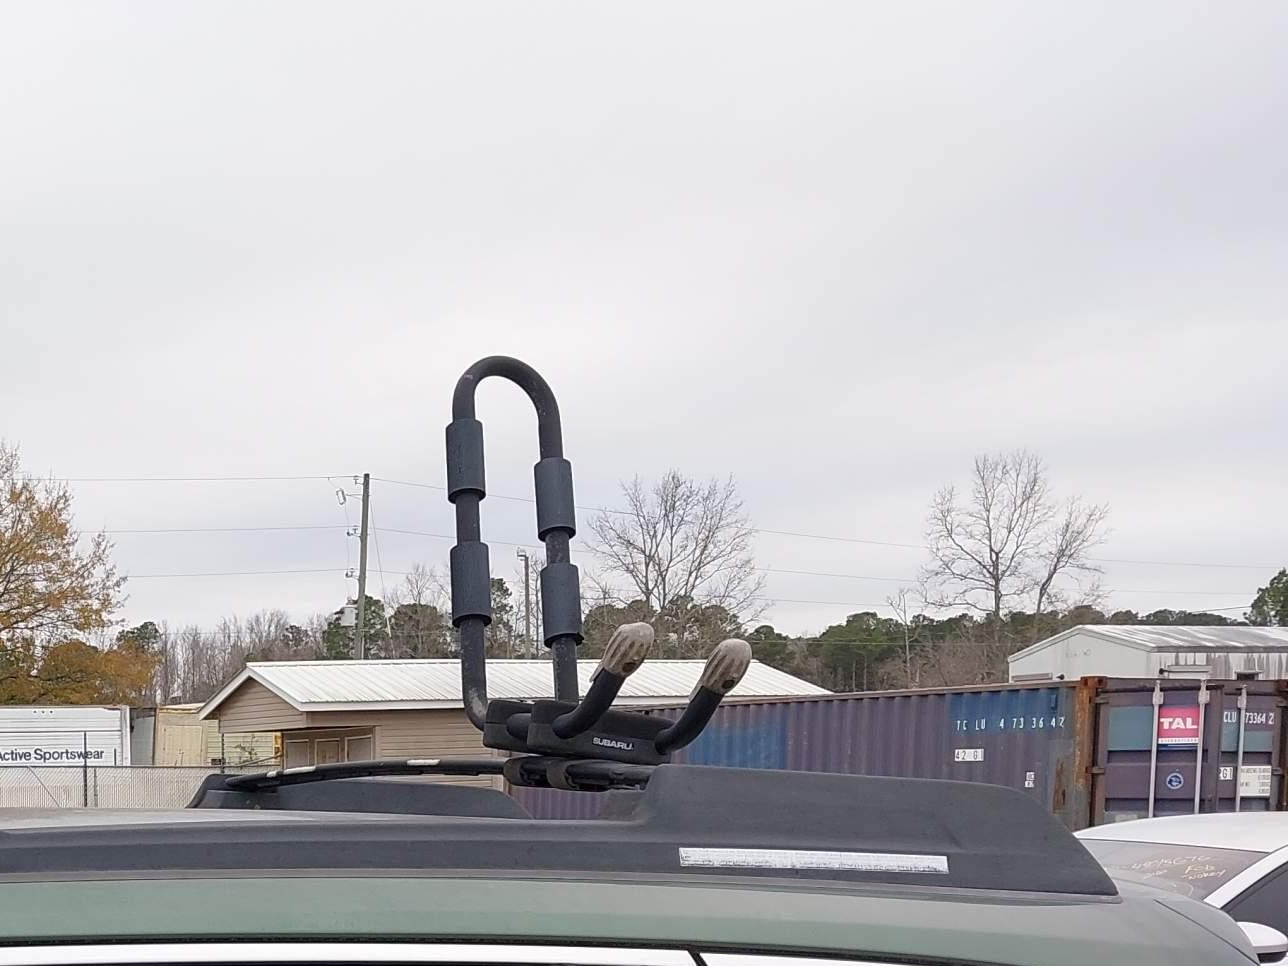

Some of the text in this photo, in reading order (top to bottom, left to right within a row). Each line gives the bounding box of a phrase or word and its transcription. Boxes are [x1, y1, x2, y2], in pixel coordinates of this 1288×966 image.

[1160, 717, 1198, 730] TAL
[593, 737, 632, 750] SUBARU
[34, 748, 104, 763] Sportswear
